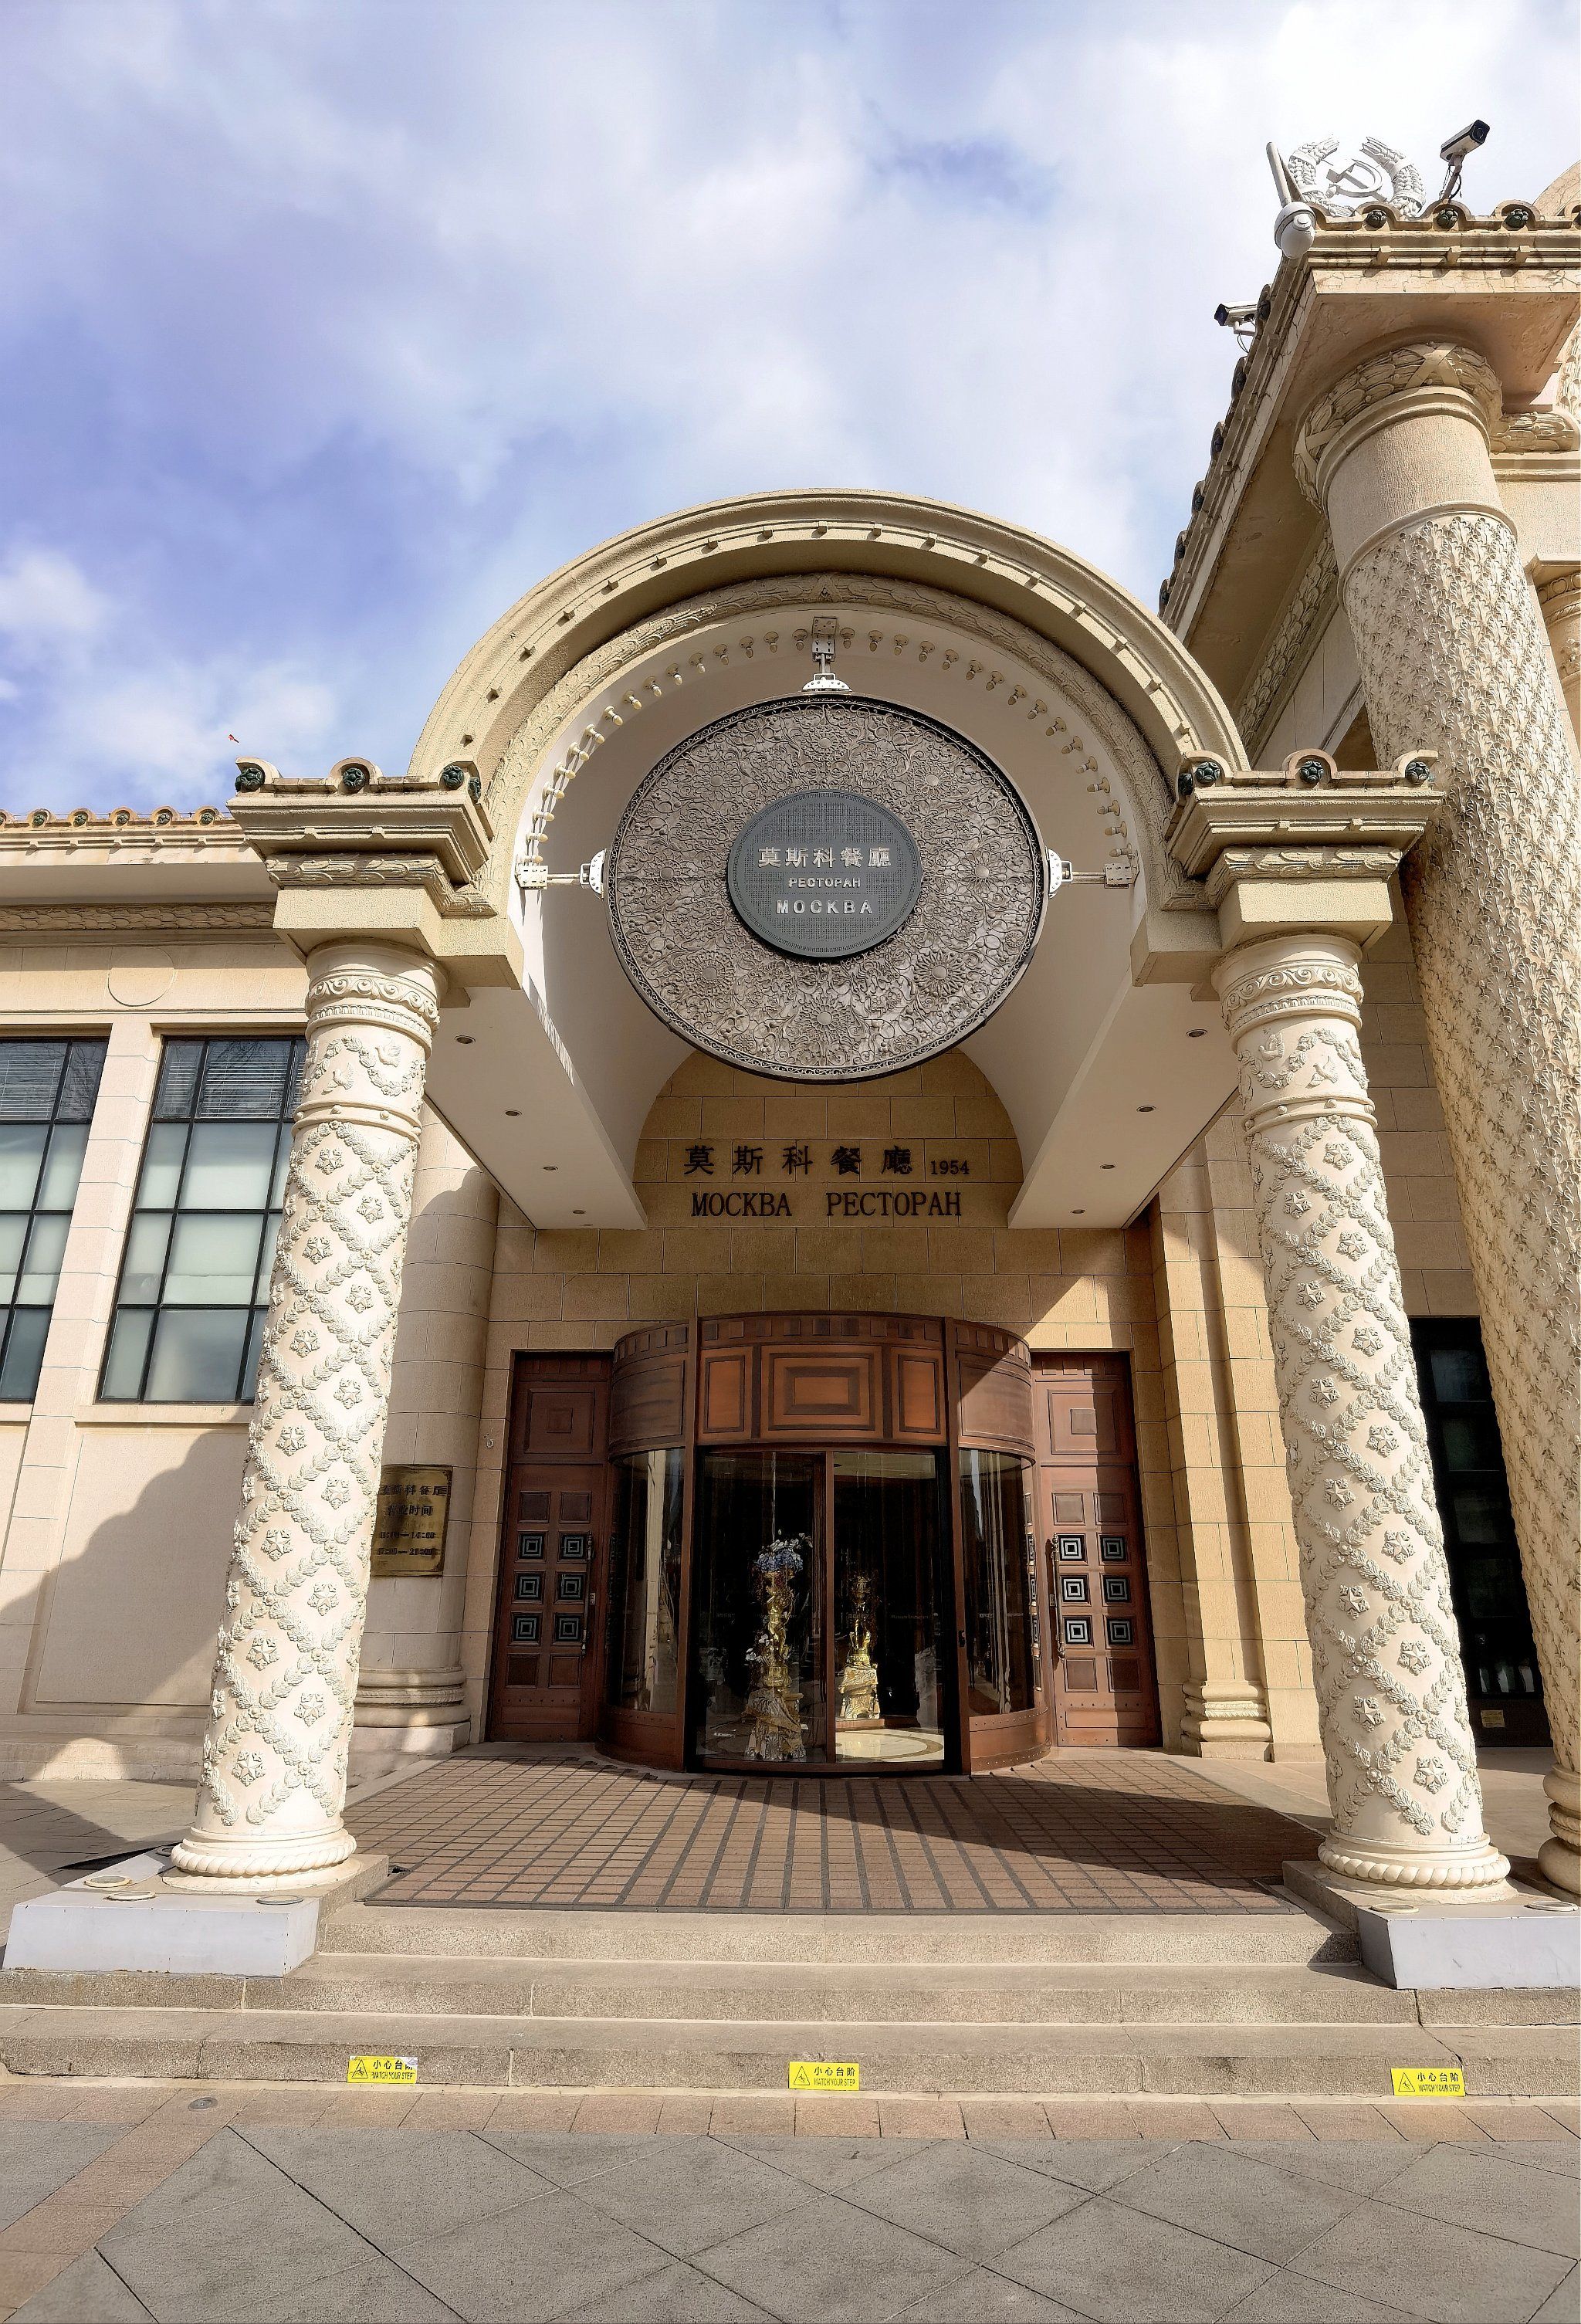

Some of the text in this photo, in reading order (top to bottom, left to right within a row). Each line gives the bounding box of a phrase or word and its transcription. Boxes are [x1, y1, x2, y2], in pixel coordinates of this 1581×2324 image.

[757, 846, 892, 868] 莫斯科餐廳
[788, 877, 862, 888] РЕСТОРАН
[776, 899, 873, 915] МОСКВА
[683, 1144, 913, 1176] 莫斯科餐廳
[929, 1160, 970, 1175] 1954
[690, 1191, 962, 1218] МОСКВА РЕСТОРАН
[388, 2072, 401, 2080] YOUR
[814, 2066, 855, 2077] 小心台阶
[1417, 2072, 1459, 2082] 小心台阶
[1418, 2084, 1435, 2092] WATCH
[1436, 2084, 1448, 2092] YOUR
